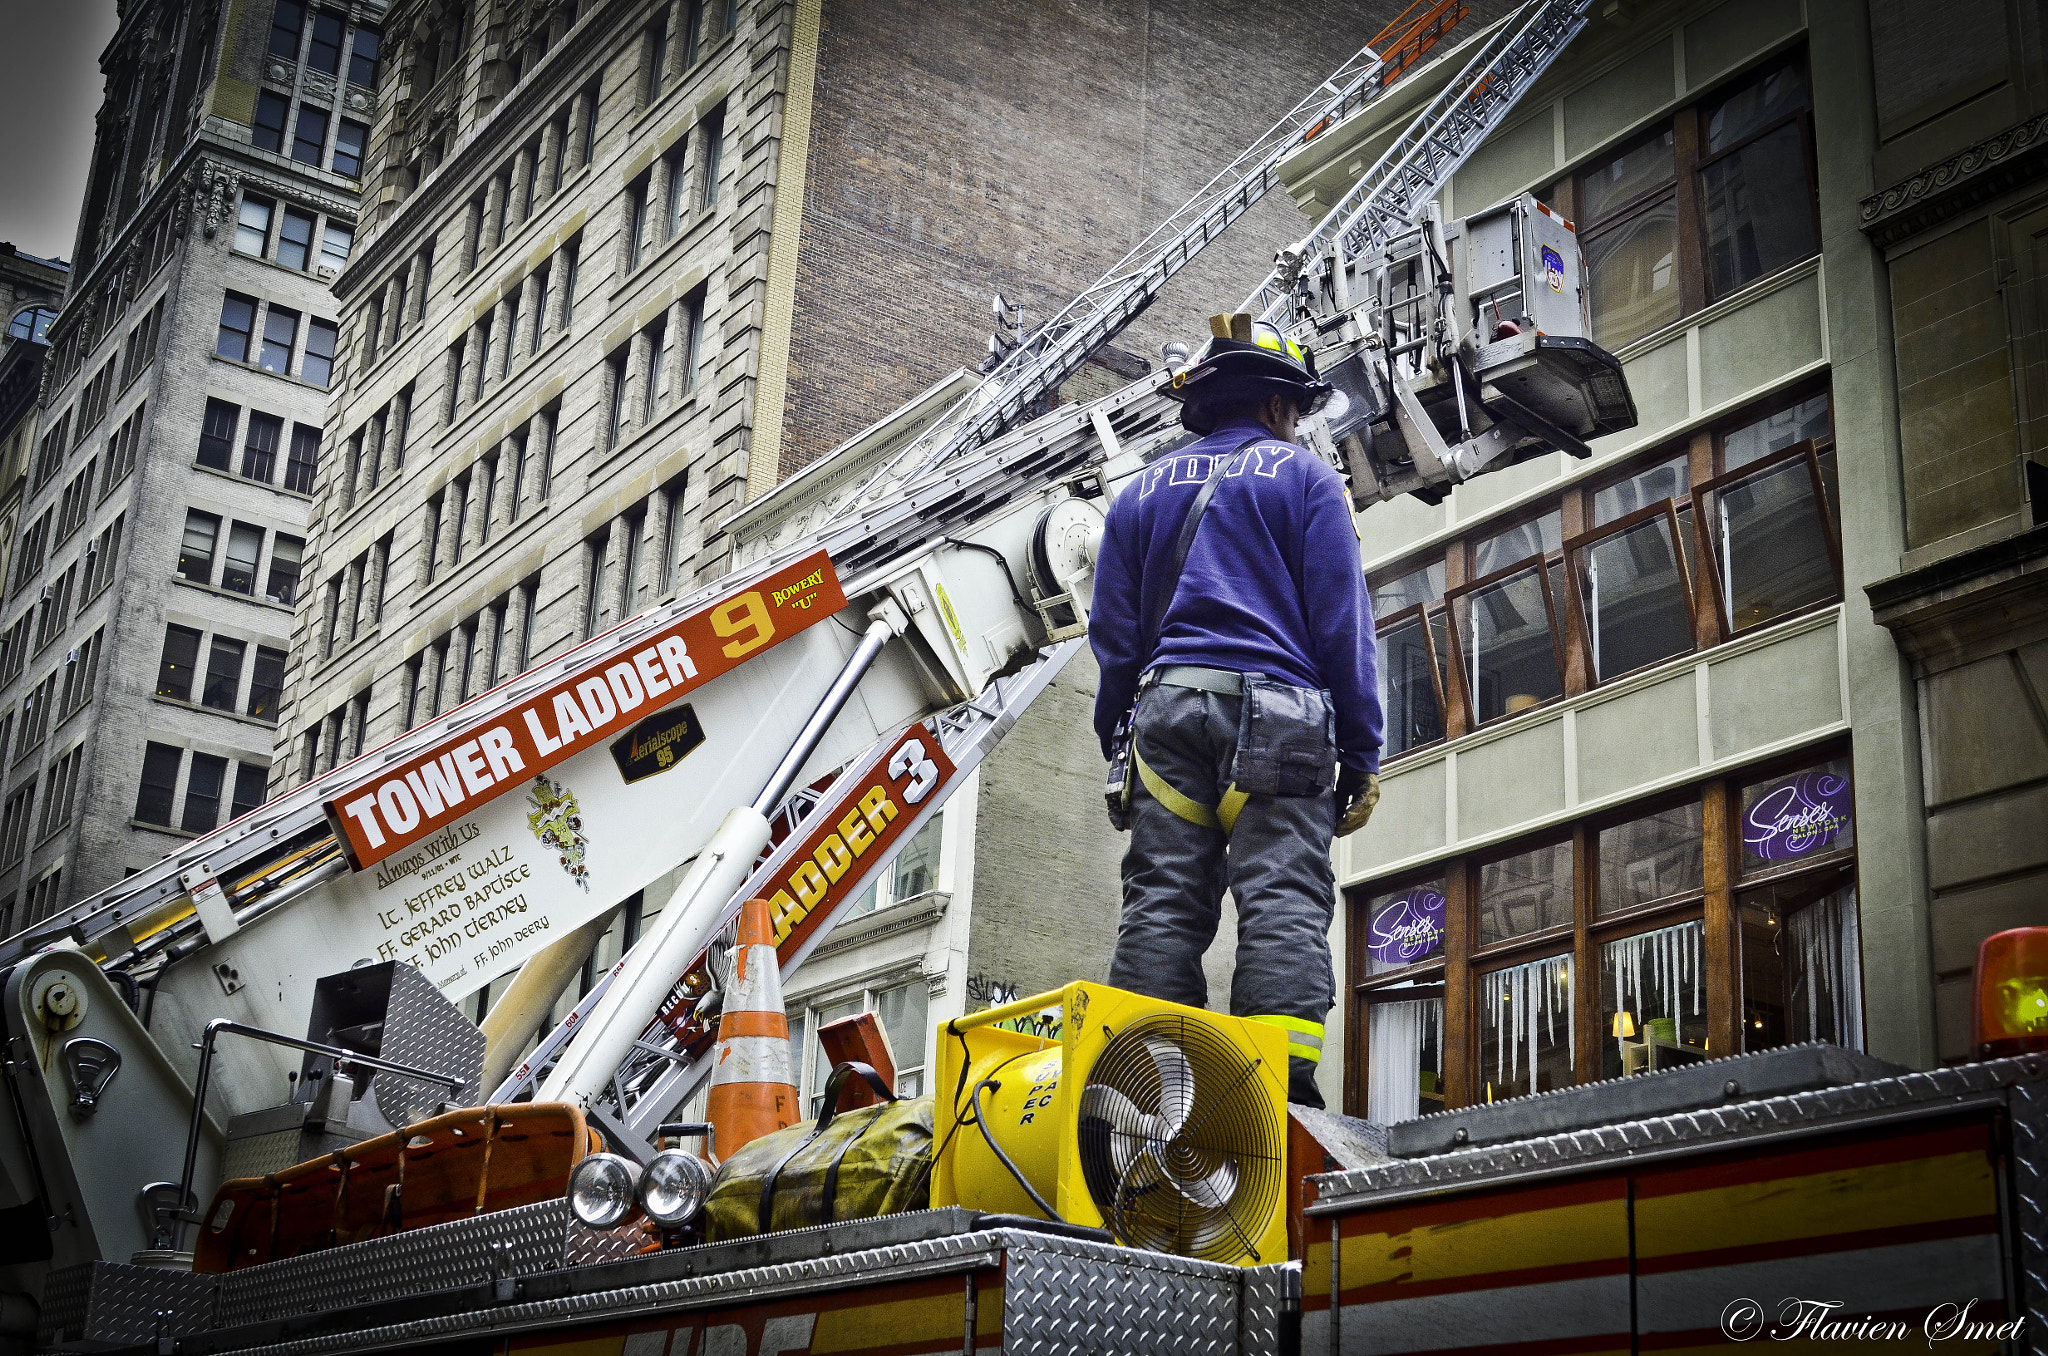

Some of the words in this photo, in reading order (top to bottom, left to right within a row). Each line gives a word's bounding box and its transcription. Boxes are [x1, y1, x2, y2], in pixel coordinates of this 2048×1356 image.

[1139, 445, 1295, 501] FDNY
[771, 567, 825, 609] BOWERY
[344, 726, 527, 850] TOWER
[523, 635, 699, 758] LADDER
[709, 591, 776, 659] 9
[625, 720, 688, 766] Aerialscope
[656, 746, 674, 768] 95
[1744, 785, 1834, 843] Senses
[376, 855, 425, 889] Always
[424, 825, 459, 859] With
[458, 821, 481, 841] Us
[768, 784, 900, 950] ADDER
[887, 738, 940, 805] 3
[1367, 900, 1435, 948] Senses
[660, 982, 692, 1017] RECON
